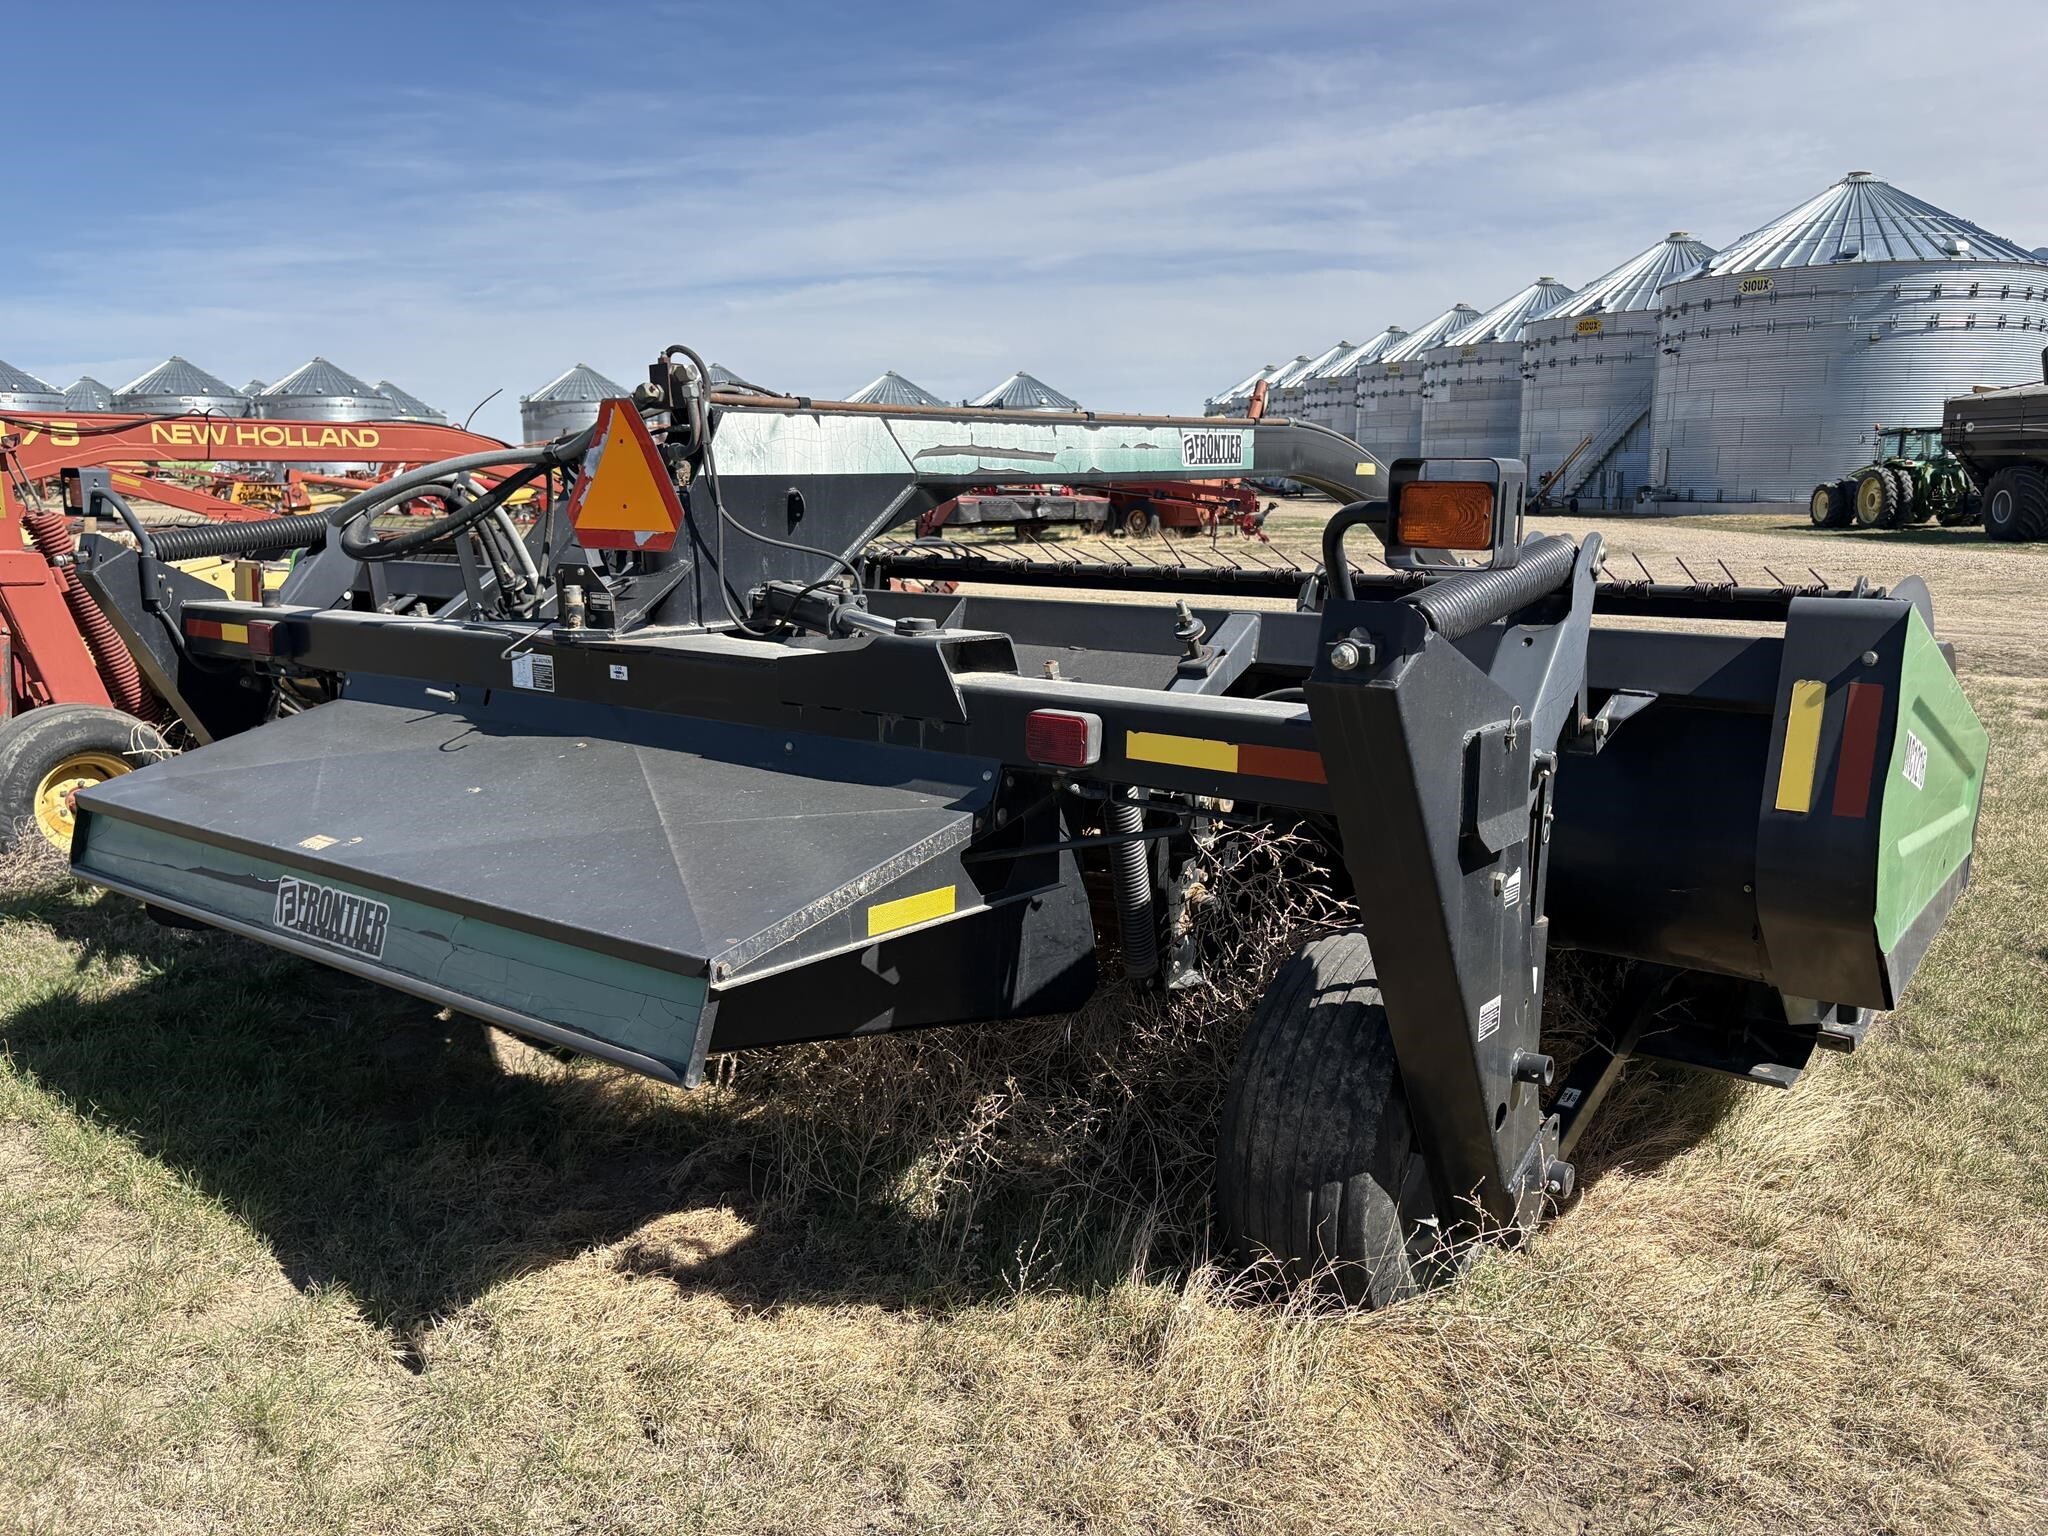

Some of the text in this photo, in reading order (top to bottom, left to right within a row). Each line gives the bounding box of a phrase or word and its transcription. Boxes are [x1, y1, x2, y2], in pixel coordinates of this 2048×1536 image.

[1742, 279, 1769, 292] SIOUX
[1578, 320, 1599, 331] SIOUX
[0, 421, 80, 447] 75
[151, 424, 380, 448] NEW HOLLAND
[1194, 433, 1242, 460] FRONTIER
[299, 881, 388, 948] FRONTIER
